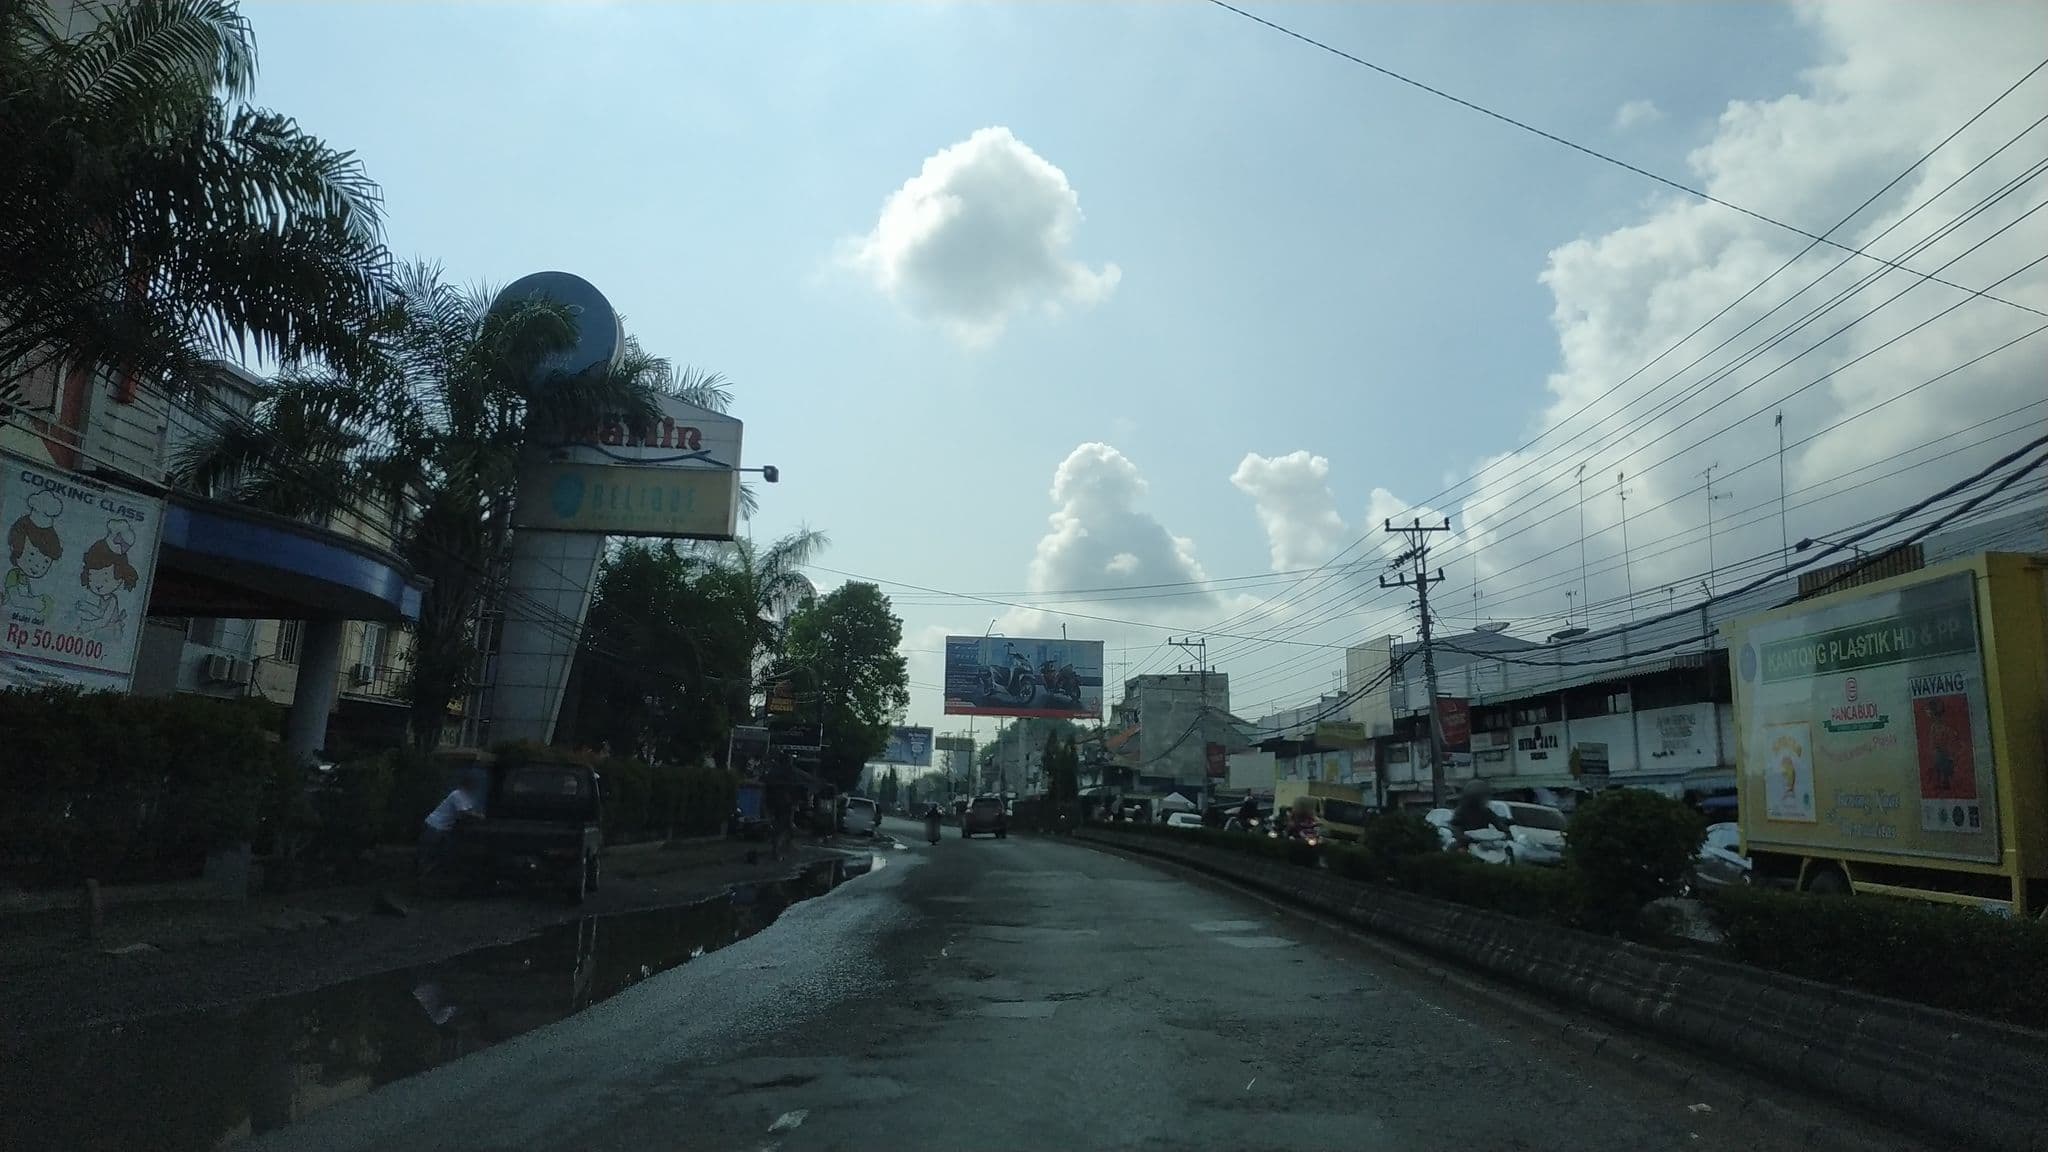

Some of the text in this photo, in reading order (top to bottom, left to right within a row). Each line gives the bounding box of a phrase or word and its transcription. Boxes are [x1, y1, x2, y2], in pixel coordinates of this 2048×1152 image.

[21, 470, 94, 505] COOKING
[100, 498, 145, 522] CLASS
[7, 622, 29, 649] Rp
[1767, 642, 1827, 673] KANTONG
[1829, 630, 1891, 663] PLASTIK
[1911, 672, 1965, 697] WAYANG
